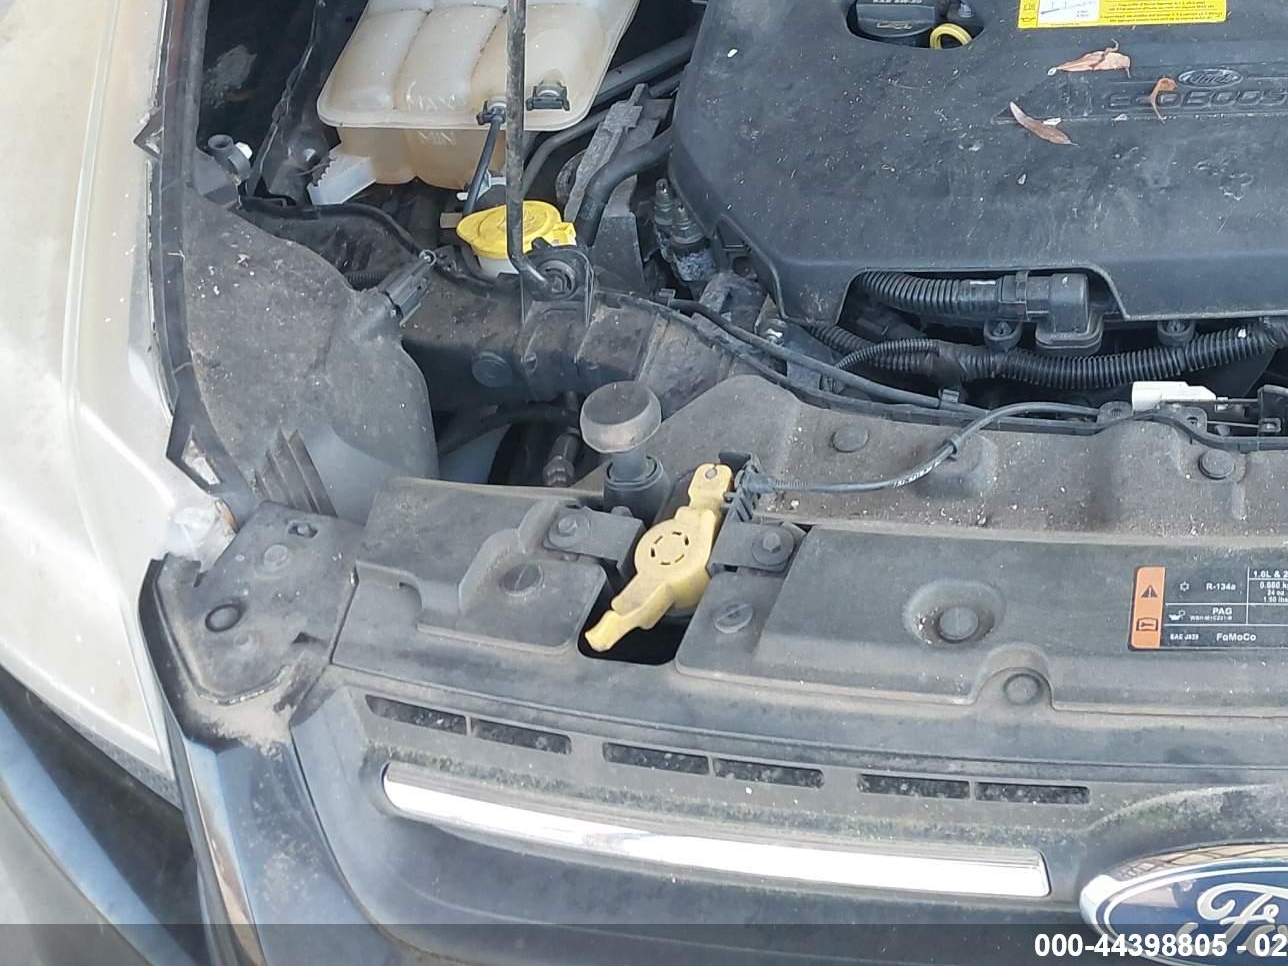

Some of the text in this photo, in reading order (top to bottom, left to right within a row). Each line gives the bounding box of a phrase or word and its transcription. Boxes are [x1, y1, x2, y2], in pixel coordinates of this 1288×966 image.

[1274, 570, 1281, 578] &
[1206, 582, 1236, 591] R-134a
[1212, 607, 1233, 615] PAG
[1216, 632, 1257, 641] FoMoCo
